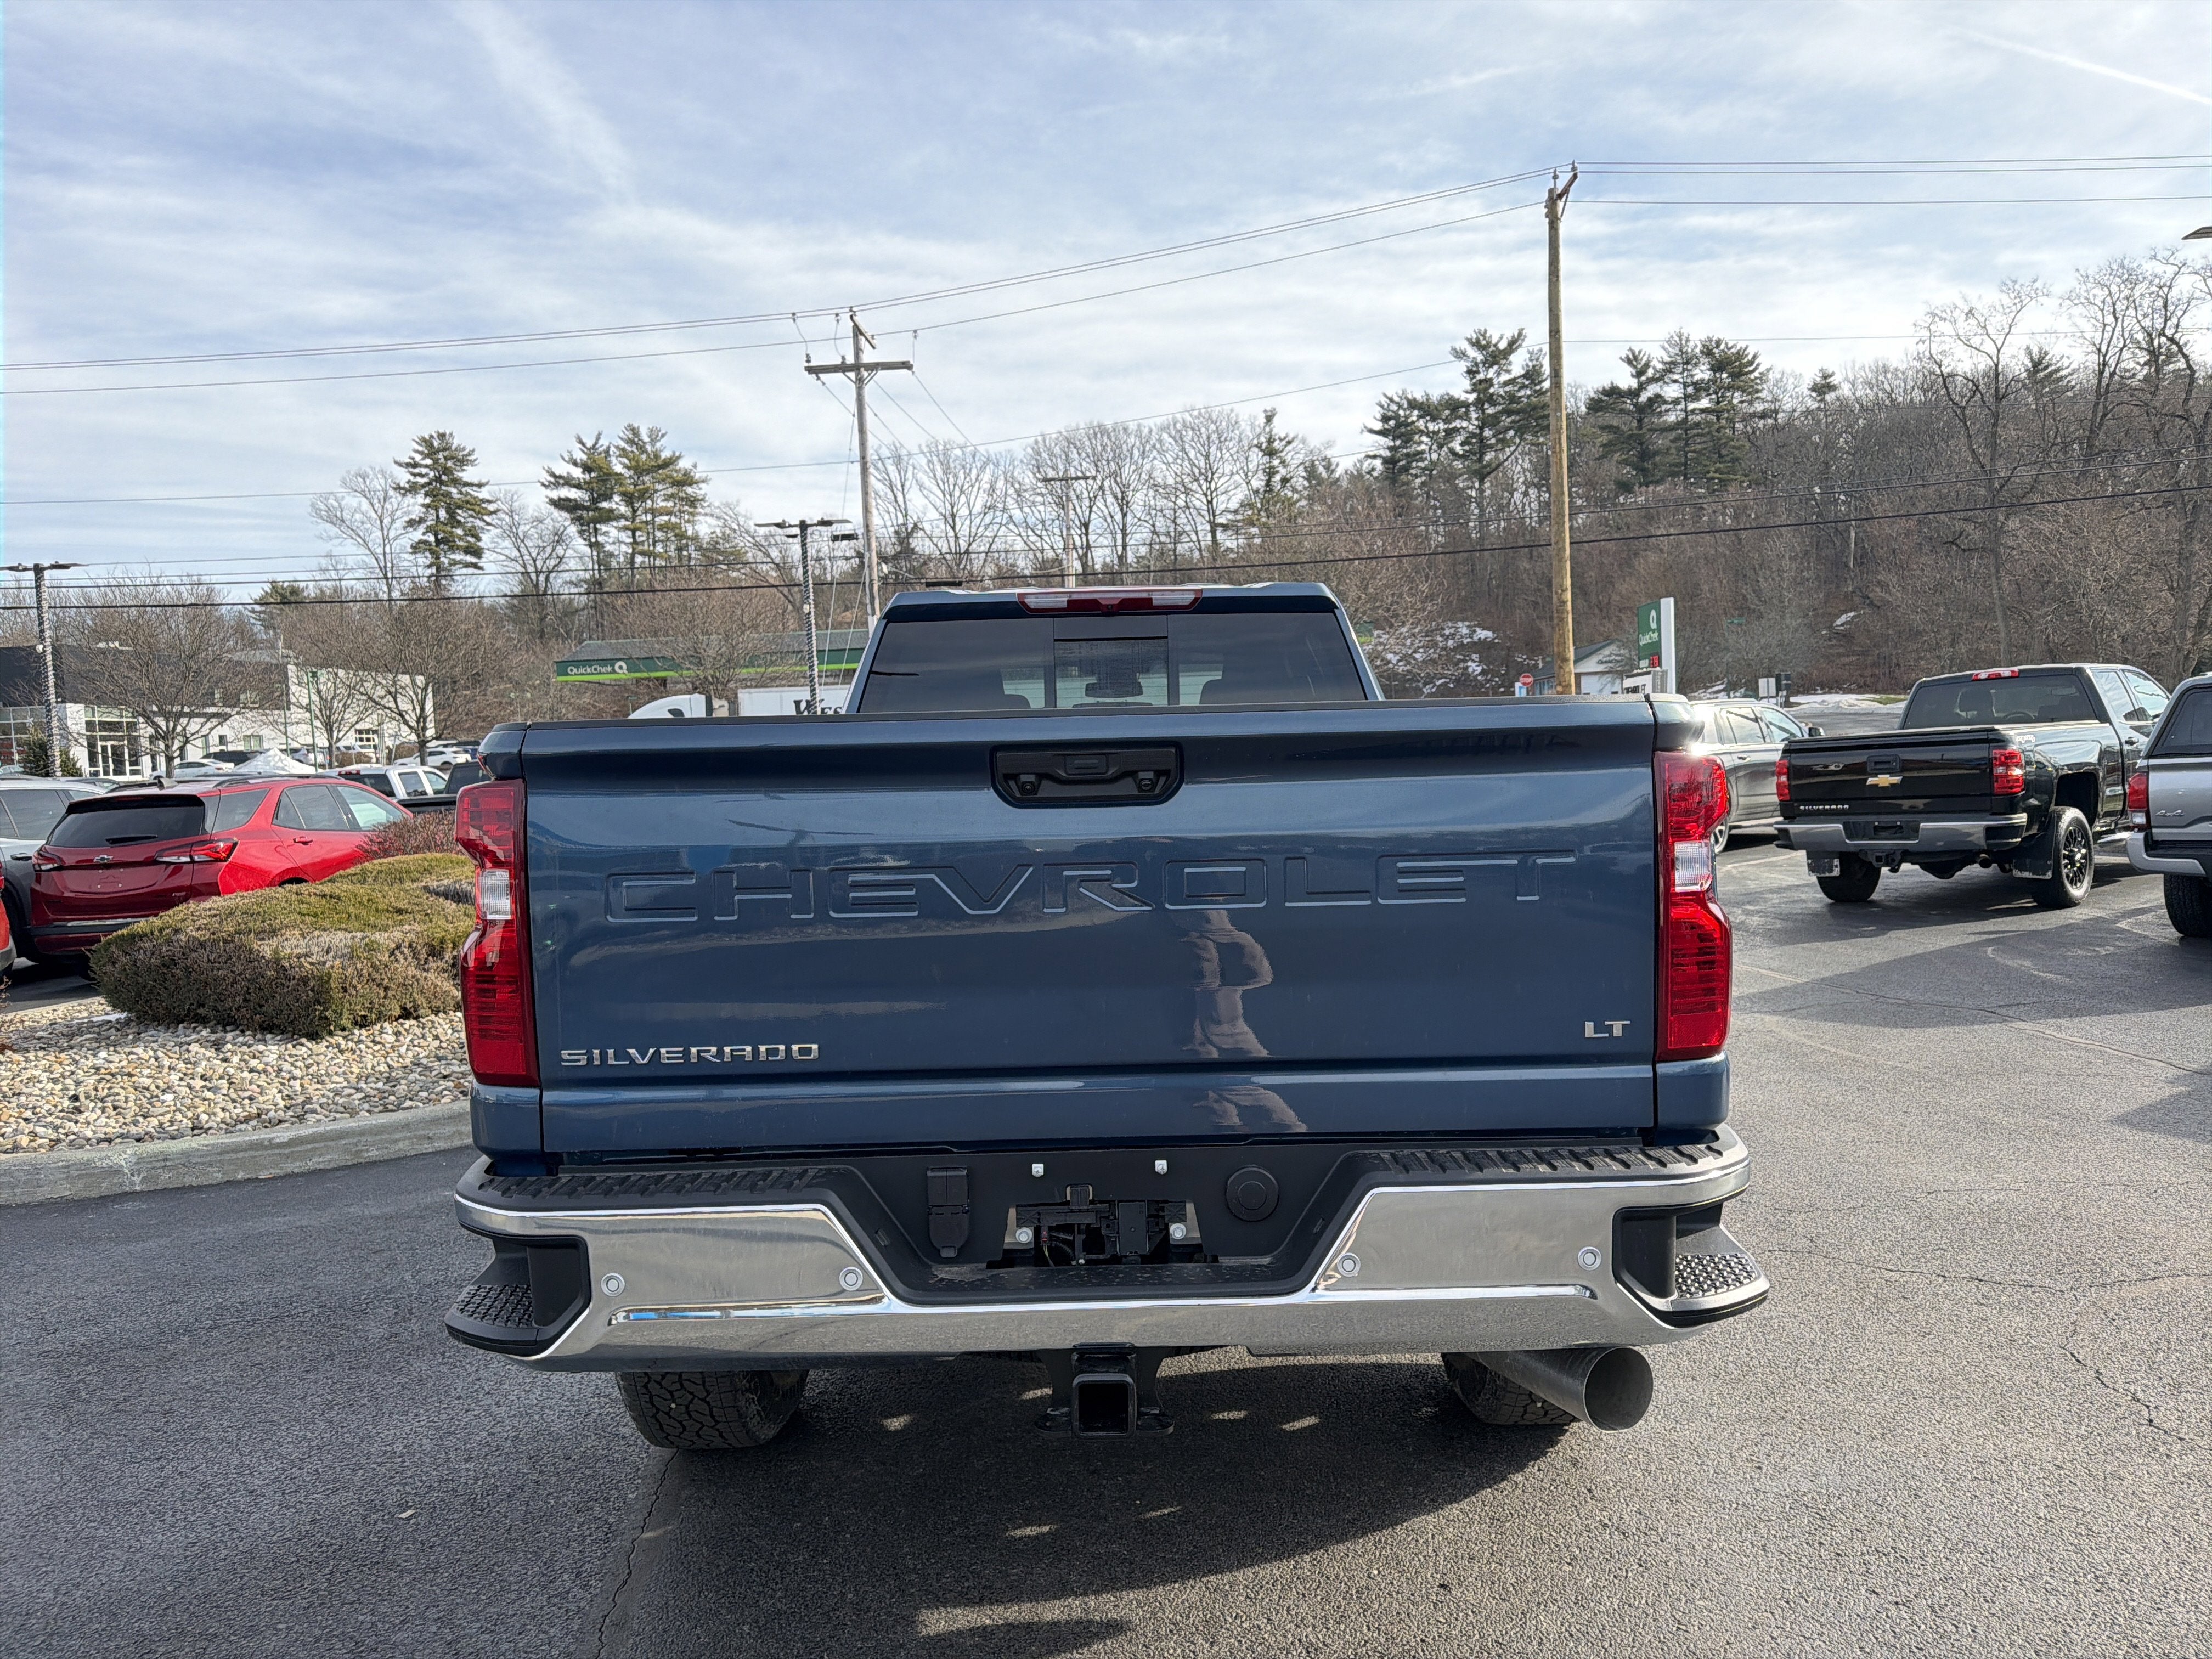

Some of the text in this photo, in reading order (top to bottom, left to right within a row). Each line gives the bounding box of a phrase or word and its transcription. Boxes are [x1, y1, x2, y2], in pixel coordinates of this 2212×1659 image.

[1639, 630, 1658, 646] QuickChek
[567, 663, 613, 675] QuickChek
[606, 849, 1578, 923] CHEVROLET
[1584, 1020, 1631, 1038] LT
[560, 1043, 820, 1066] SILVERADO
